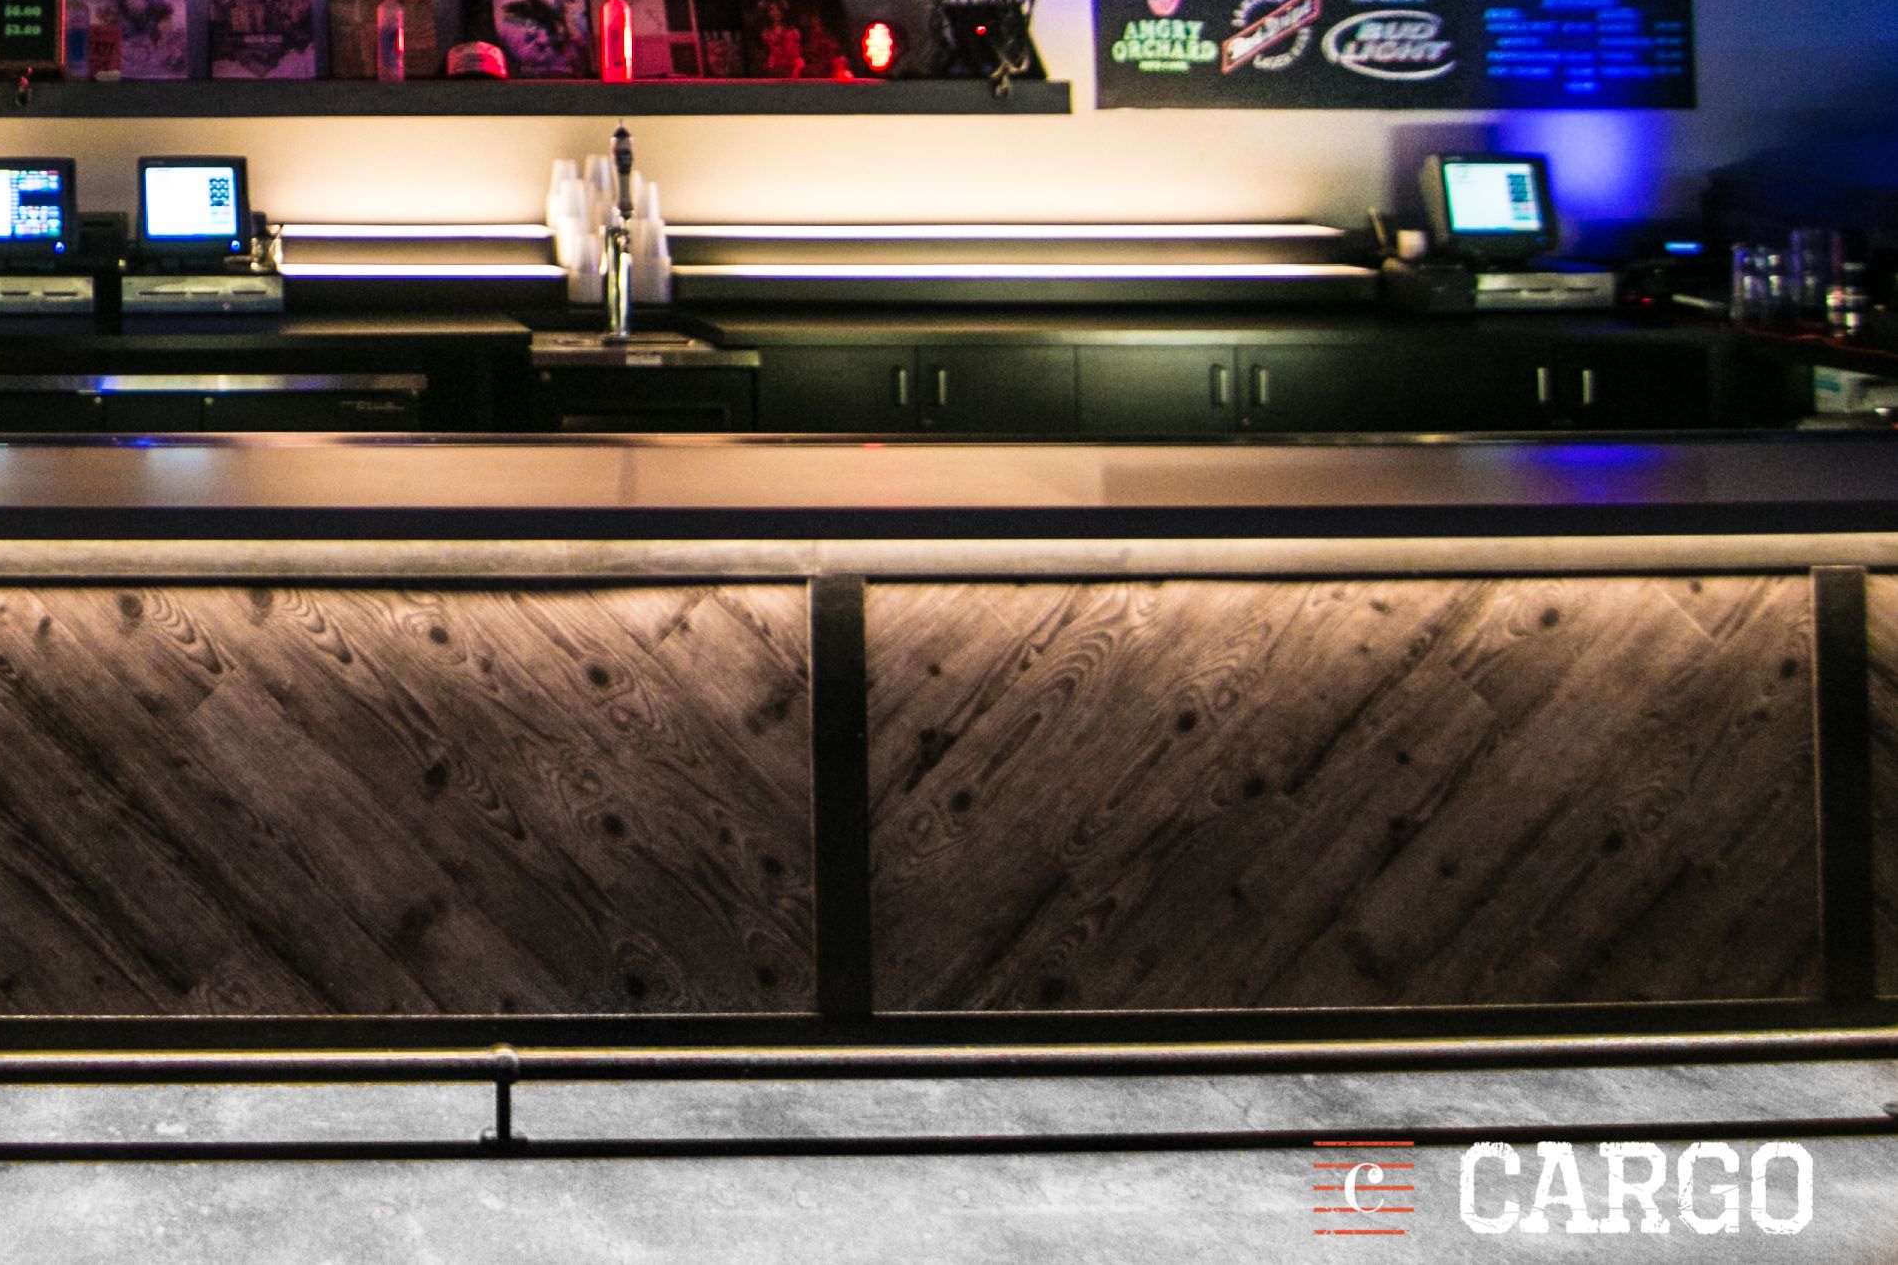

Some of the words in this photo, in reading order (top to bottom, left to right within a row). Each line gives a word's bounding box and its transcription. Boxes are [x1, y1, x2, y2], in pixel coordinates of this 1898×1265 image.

[1123, 20, 1205, 41] ANGRY
[1355, 20, 1439, 40] BUD
[1111, 39, 1219, 63] ORCHARD
[1340, 40, 1452, 62] LIGHT
